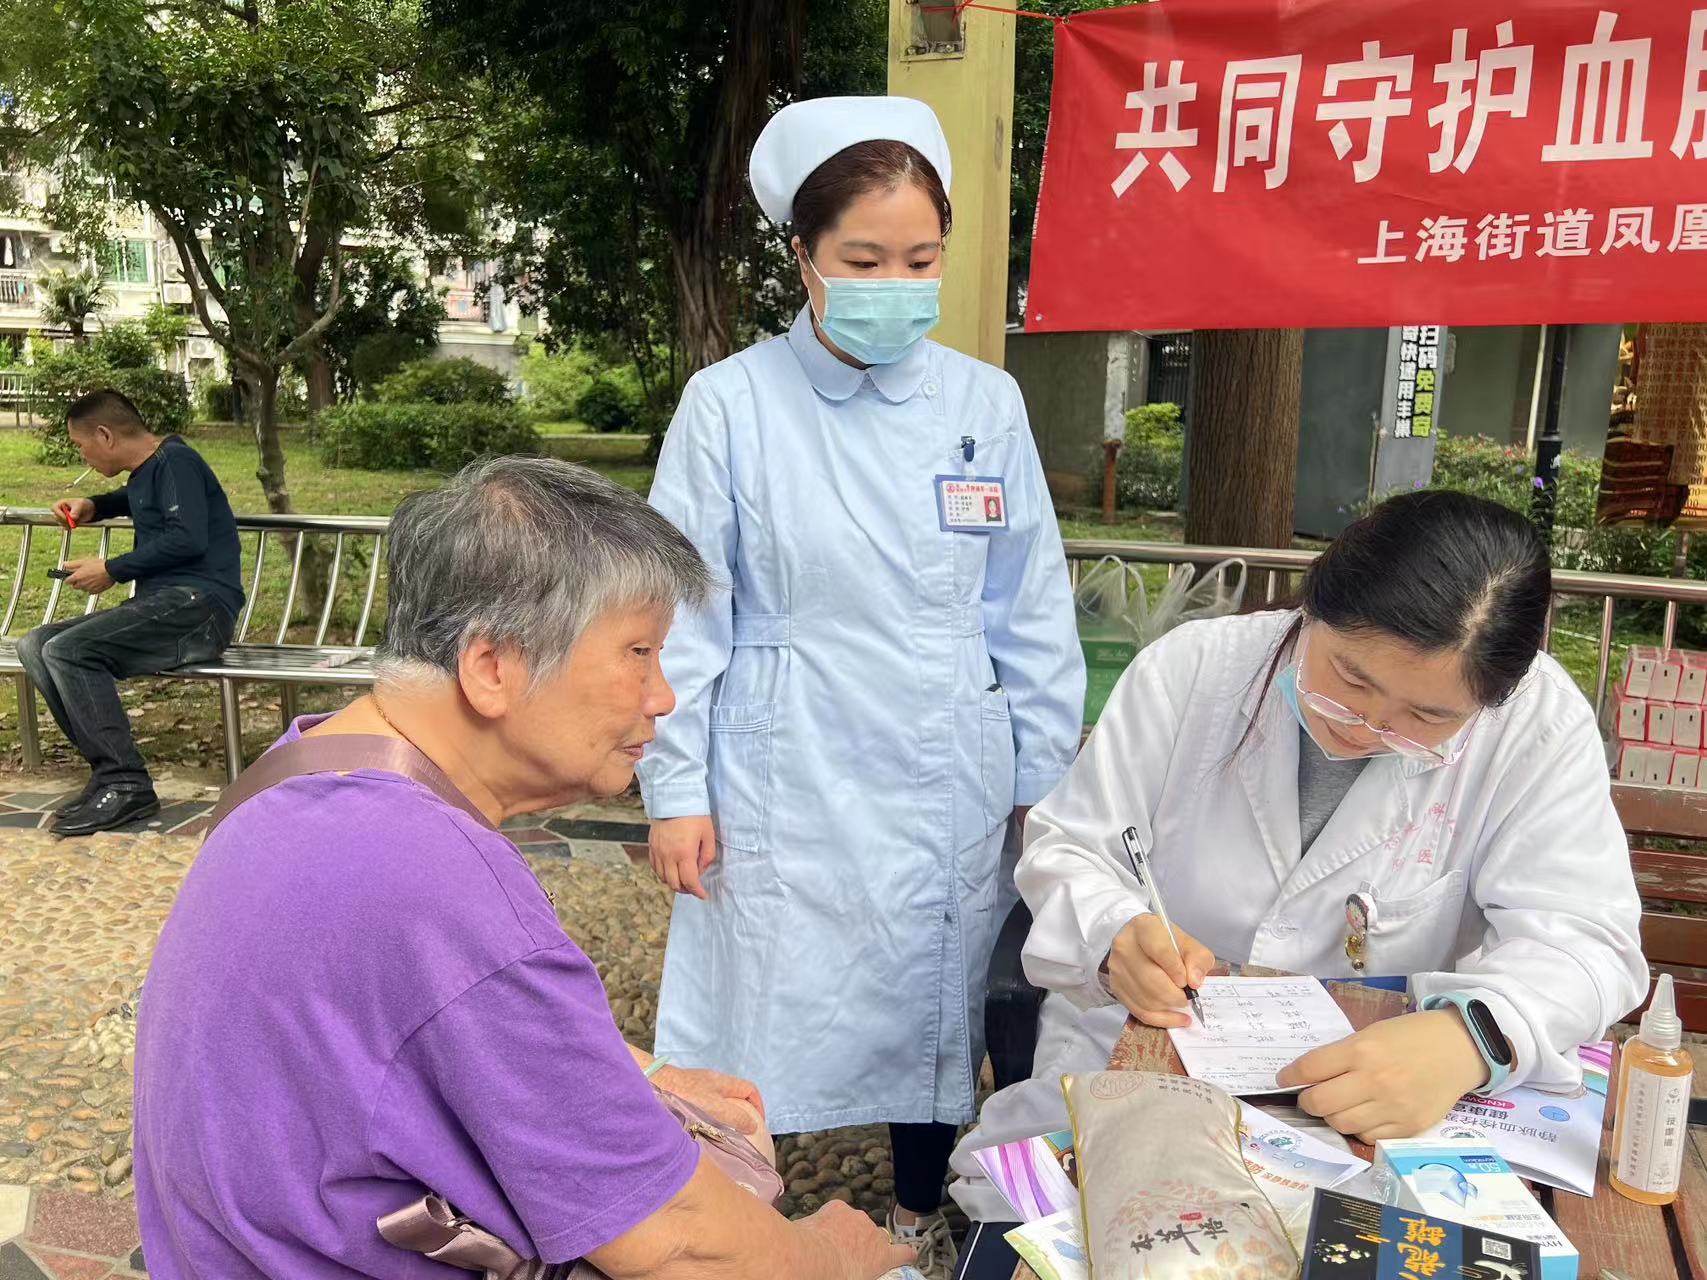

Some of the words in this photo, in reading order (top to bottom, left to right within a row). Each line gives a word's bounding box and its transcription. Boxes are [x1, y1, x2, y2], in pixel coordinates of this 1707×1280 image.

[1357, 203, 1707, 264] 上海街道凤凰
[1412, 325, 1440, 437] 扫码免费寄
